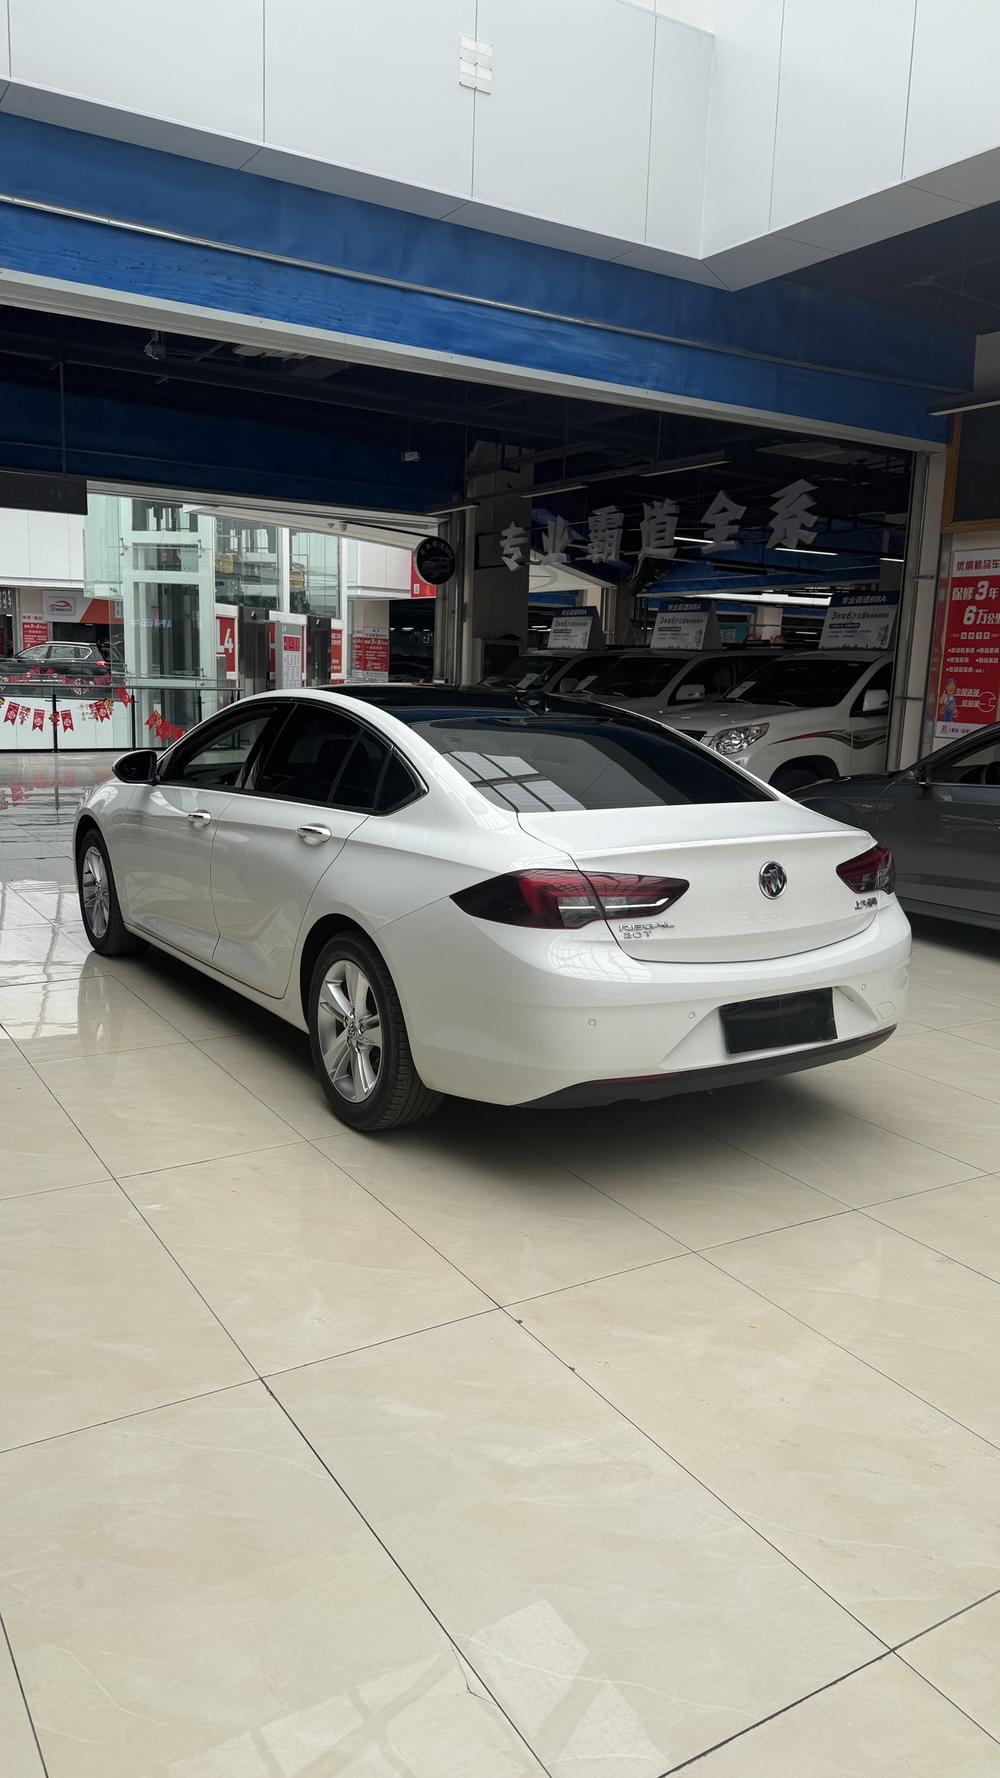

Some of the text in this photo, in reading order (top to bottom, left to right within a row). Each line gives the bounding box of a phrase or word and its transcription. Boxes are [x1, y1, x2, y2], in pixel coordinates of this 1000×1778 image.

[499, 478, 819, 573] 专业霸道全系
[952, 581, 999, 600] 保修3年
[619, 922, 675, 932] REGAL
